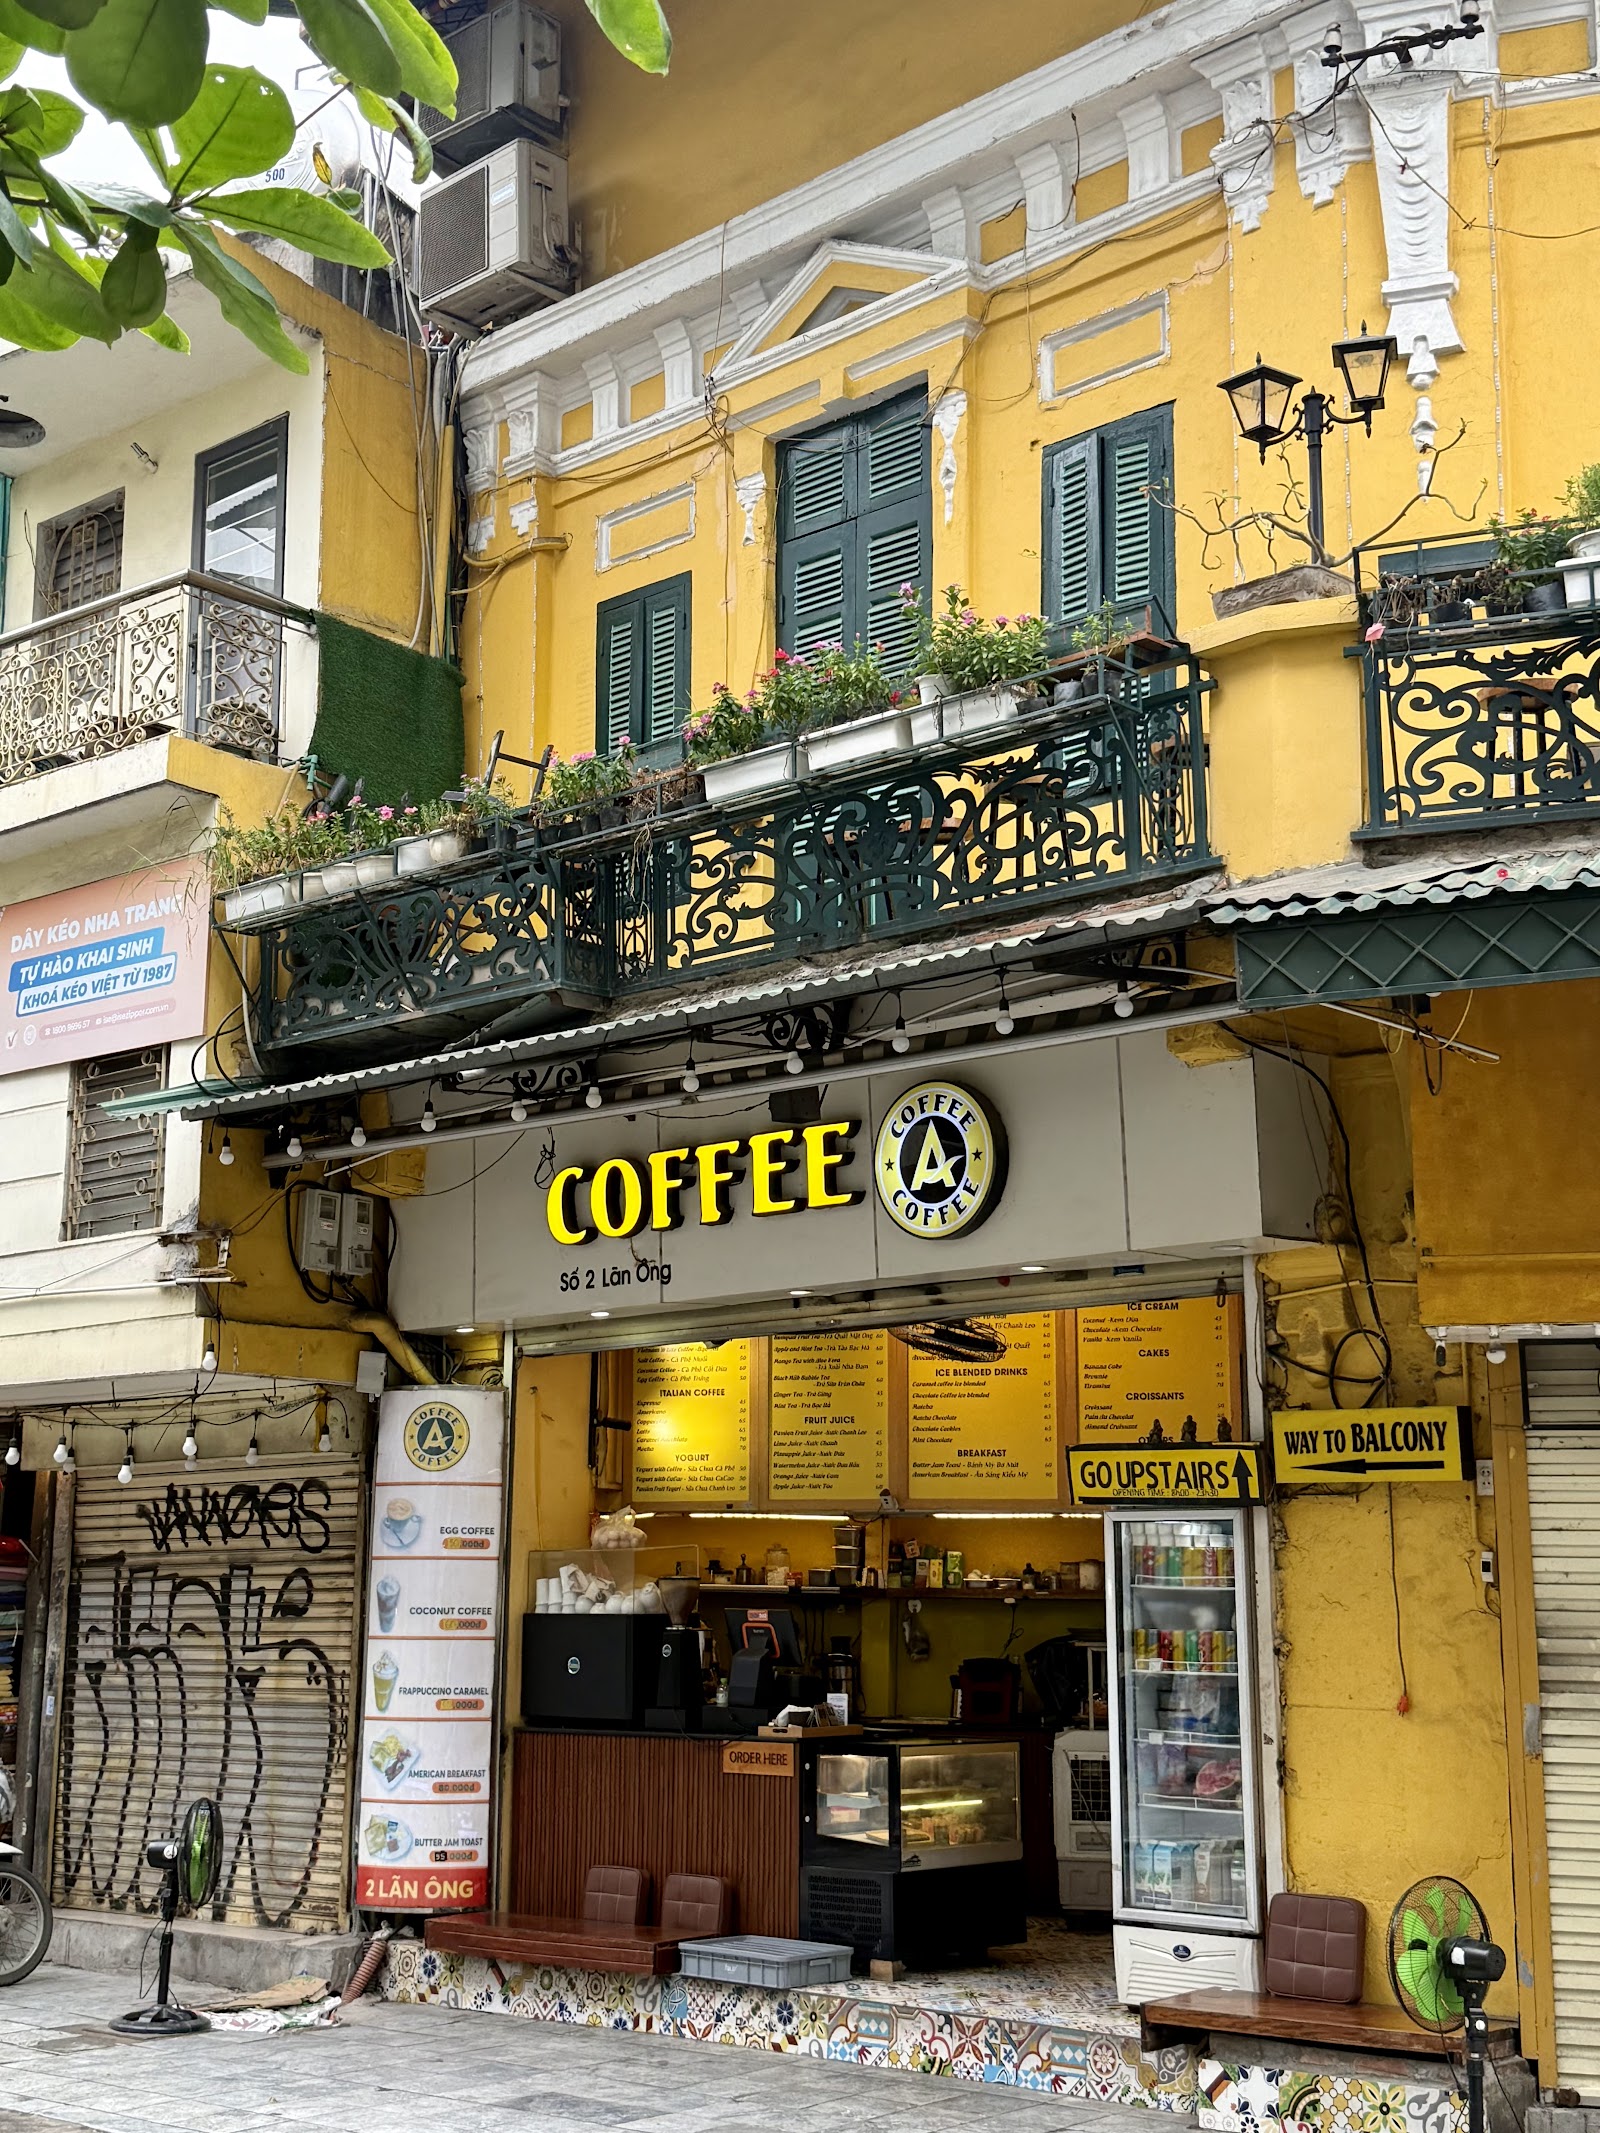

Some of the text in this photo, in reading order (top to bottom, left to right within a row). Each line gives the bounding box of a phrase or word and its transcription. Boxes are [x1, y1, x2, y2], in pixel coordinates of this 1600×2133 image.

[265, 167, 285, 183] 500
[10, 894, 183, 953] DÂY KÉO NHA TRANG
[20, 937, 154, 986] TỰ HÀO KHAI SINH
[23, 963, 172, 1010] KHOÁ KÉO VIỆT TỪ 1987
[891, 1094, 976, 1138] COFFEE
[910, 1118, 965, 1191] A
[546, 1120, 859, 1246] COFFEE
[892, 1177, 980, 1226] COFFEE
[560, 1266, 580, 1292] Số
[586, 1269, 595, 1289] 2
[636, 1258, 671, 1285] Ông
[1145, 1302, 1179, 1310] CREAM
[1138, 1349, 1169, 1357] CAKES
[936, 1368, 1028, 1376] ICE BLENDED DRINKS
[660, 1389, 691, 1397] ITALIAN
[1126, 1392, 1184, 1400] CROISSANTS
[413, 1407, 461, 1426] COFFEE
[422, 1418, 453, 1450] A
[1283, 1421, 1447, 1455] WAY TO BALCONY
[412, 1446, 460, 1466] COFFEE
[1080, 1460, 1229, 1489] GO UPSTAIRS
[1112, 1488, 1145, 1497] OPENING
[1196, 1488, 1219, 1497] 23h30
[439, 1526, 495, 1535] EGG COFFEE
[409, 1606, 493, 1616] COCONUT COFFEE
[398, 1687, 489, 1696] FRAPPUCCINO CARAMEL
[729, 1750, 788, 1766] ORDER HERE
[408, 1769, 486, 1778] AMERICAN BREAKFAST
[414, 1837, 483, 1847] BUTTER JAM TOAST
[365, 1874, 474, 1899] 2 LÃN ÔNG
